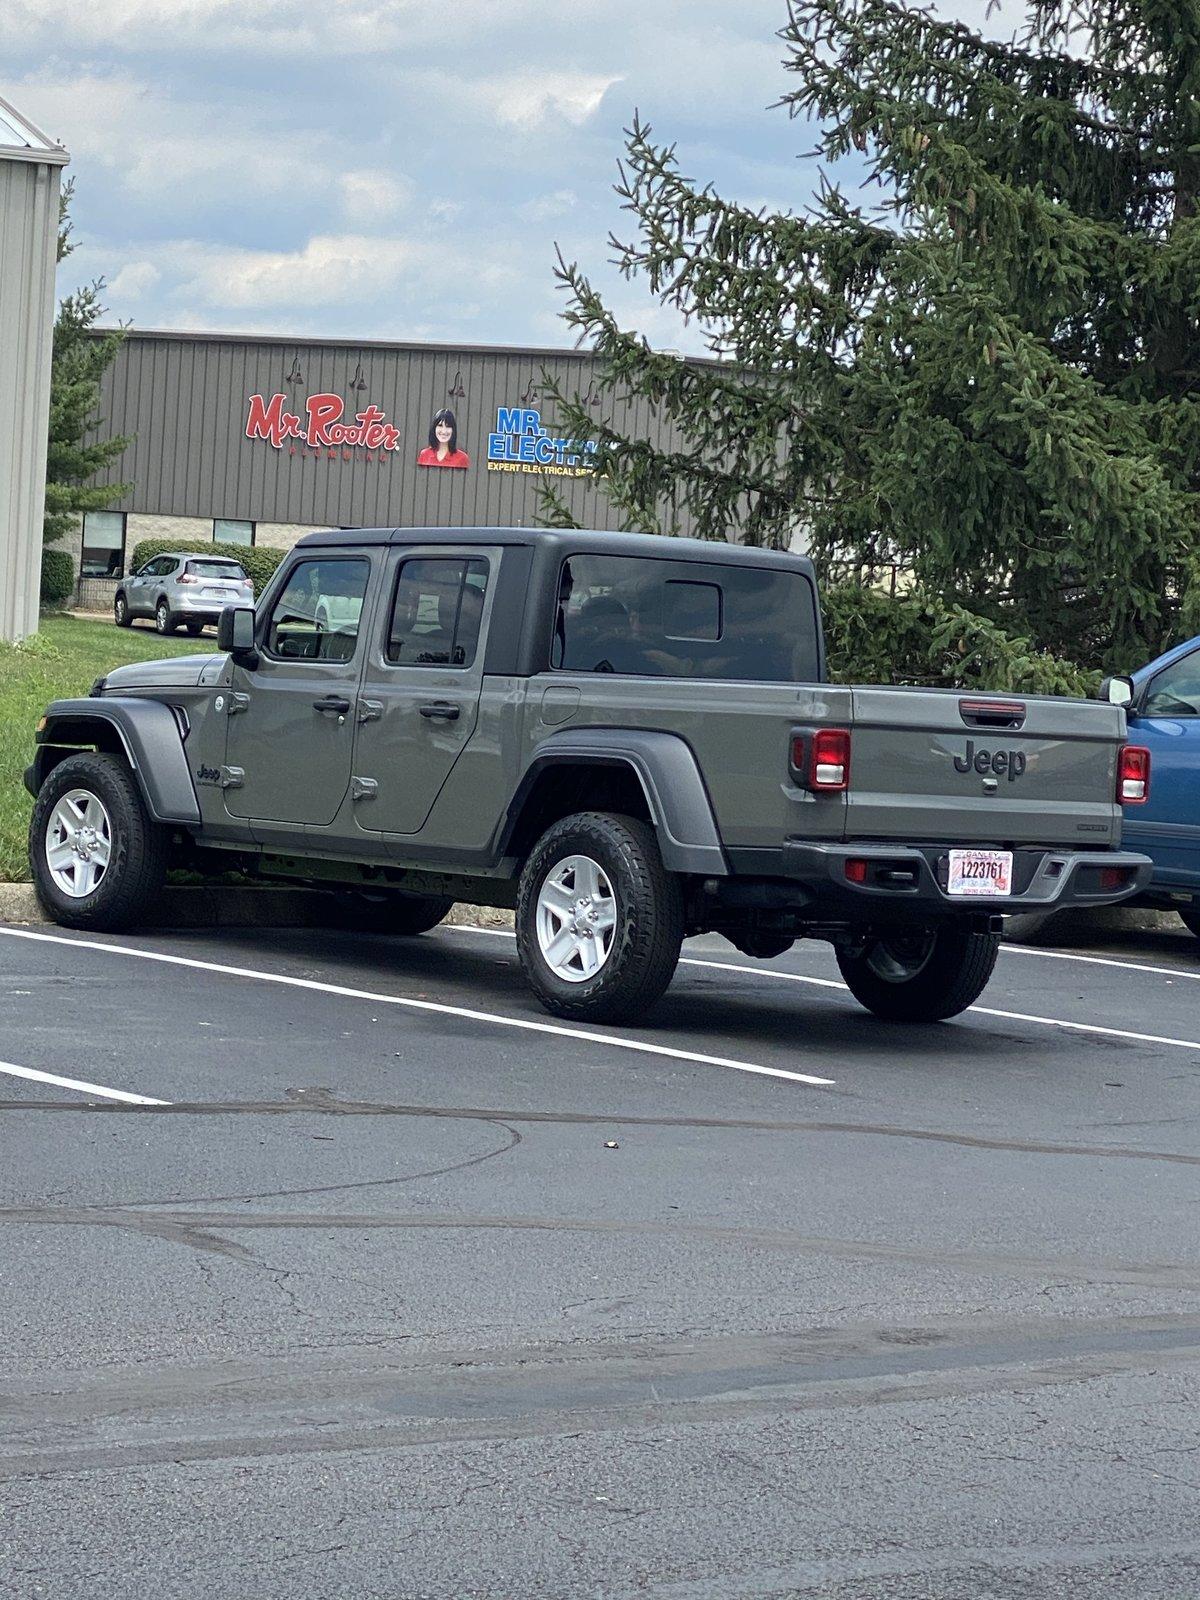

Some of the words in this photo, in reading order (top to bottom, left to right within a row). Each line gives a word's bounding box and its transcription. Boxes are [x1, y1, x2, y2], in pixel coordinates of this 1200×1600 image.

[246, 393, 306, 448] Mr.
[497, 407, 547, 436] MR.
[488, 433, 616, 467] ELECT
[487, 462, 521, 472] EXPERT
[197, 763, 220, 782] Jeep
[954, 740, 1026, 782] Jeep
[962, 861, 1003, 879] L223761
